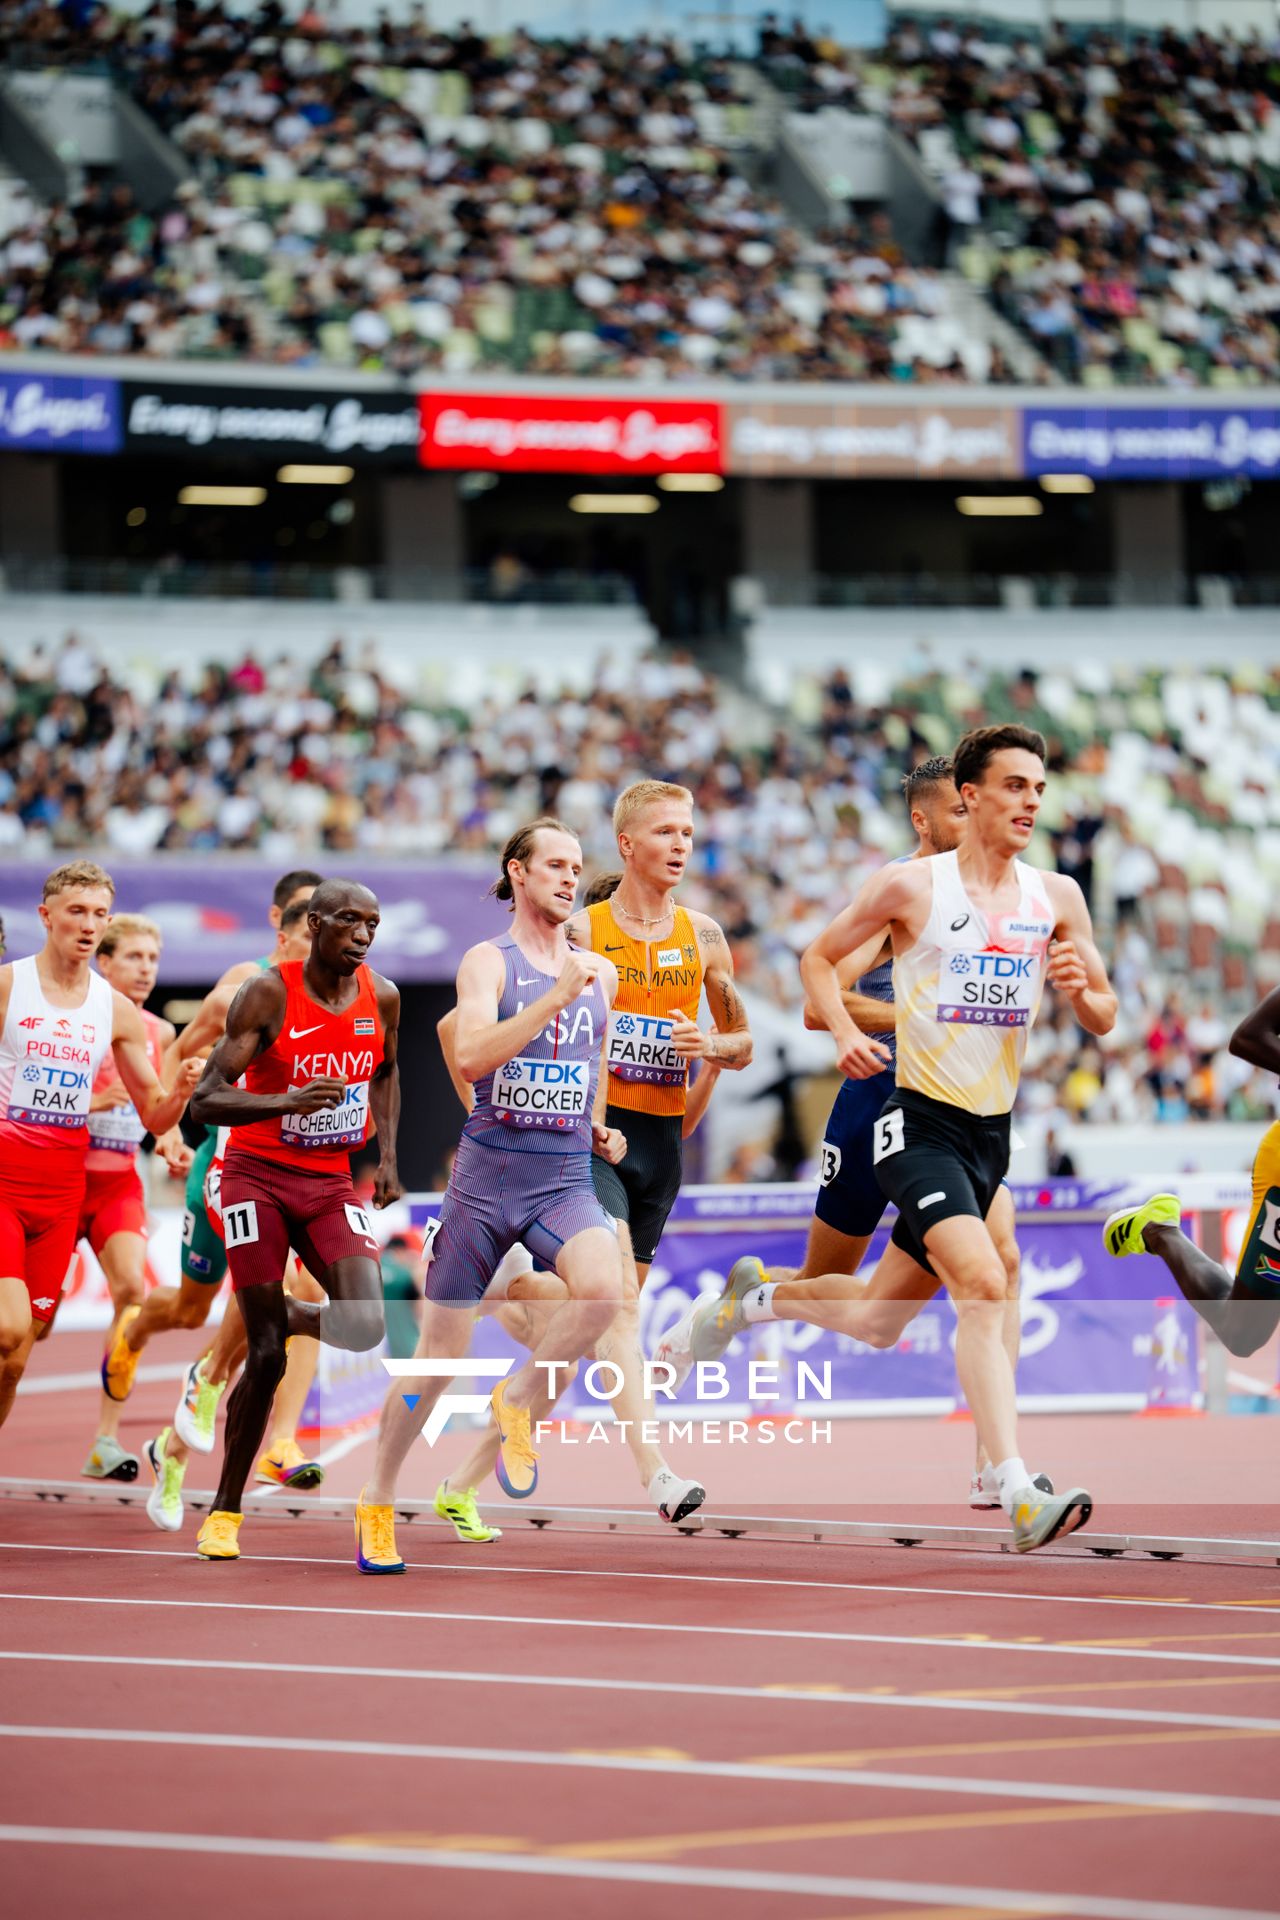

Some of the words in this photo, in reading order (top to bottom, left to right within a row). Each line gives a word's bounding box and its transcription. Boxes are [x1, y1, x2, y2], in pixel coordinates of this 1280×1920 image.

[1009, 923, 1039, 933] Allianz
[659, 953, 681, 964] WGV
[972, 955, 1034, 978] TDK
[617, 965, 696, 987] ERMANY
[963, 982, 1020, 1005] SISK
[18, 1016, 45, 1030] 4F
[636, 1018, 674, 1041] TD
[26, 1040, 91, 1065] POLSKA
[293, 1050, 374, 1079] KENYA
[523, 1062, 582, 1084] TDK
[42, 1067, 91, 1089] TDK
[32, 1089, 79, 1111] RAK
[498, 1084, 584, 1111] HOCKER
[299, 1107, 365, 1133] CHERUIYOT
[882, 1121, 893, 1151] 5
[228, 1209, 251, 1240] 11
[423, 1225, 435, 1249] 7
